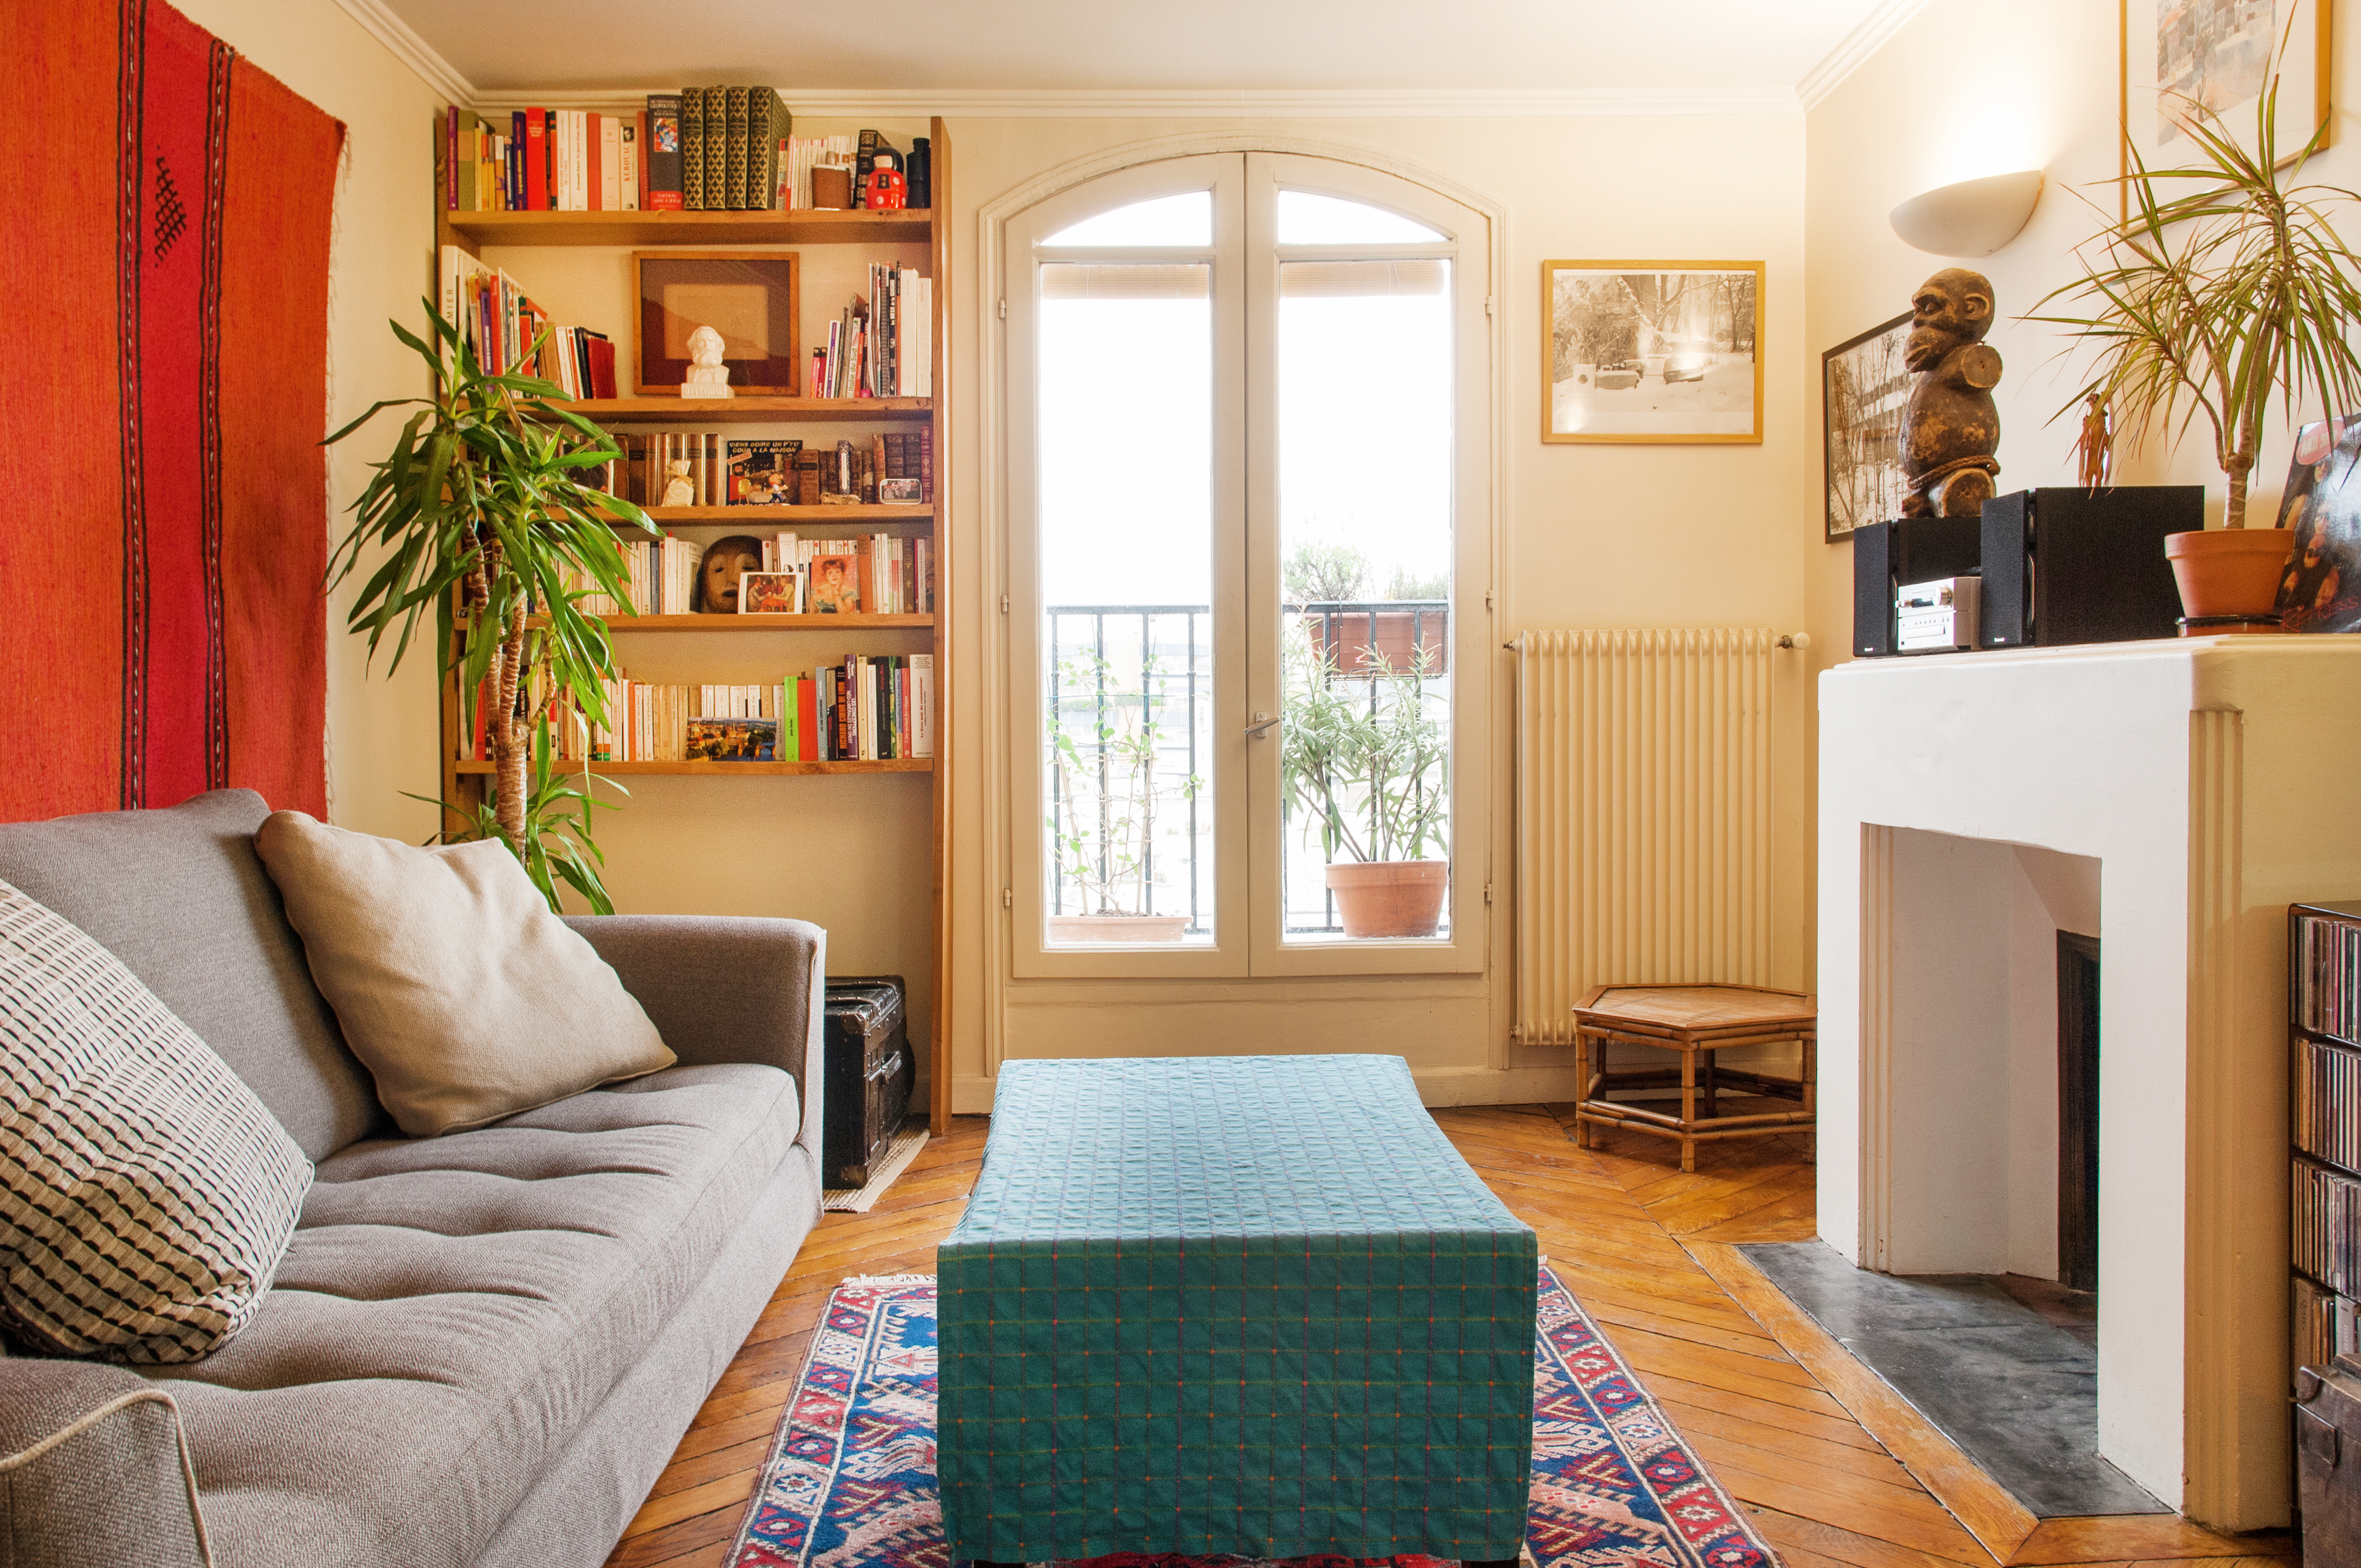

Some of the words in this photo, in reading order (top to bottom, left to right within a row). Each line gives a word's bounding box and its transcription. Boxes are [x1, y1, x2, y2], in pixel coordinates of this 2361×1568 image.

[851, 362, 856, 372] du
[684, 386, 698, 396] Das
[839, 723, 847, 749] RICHARD
